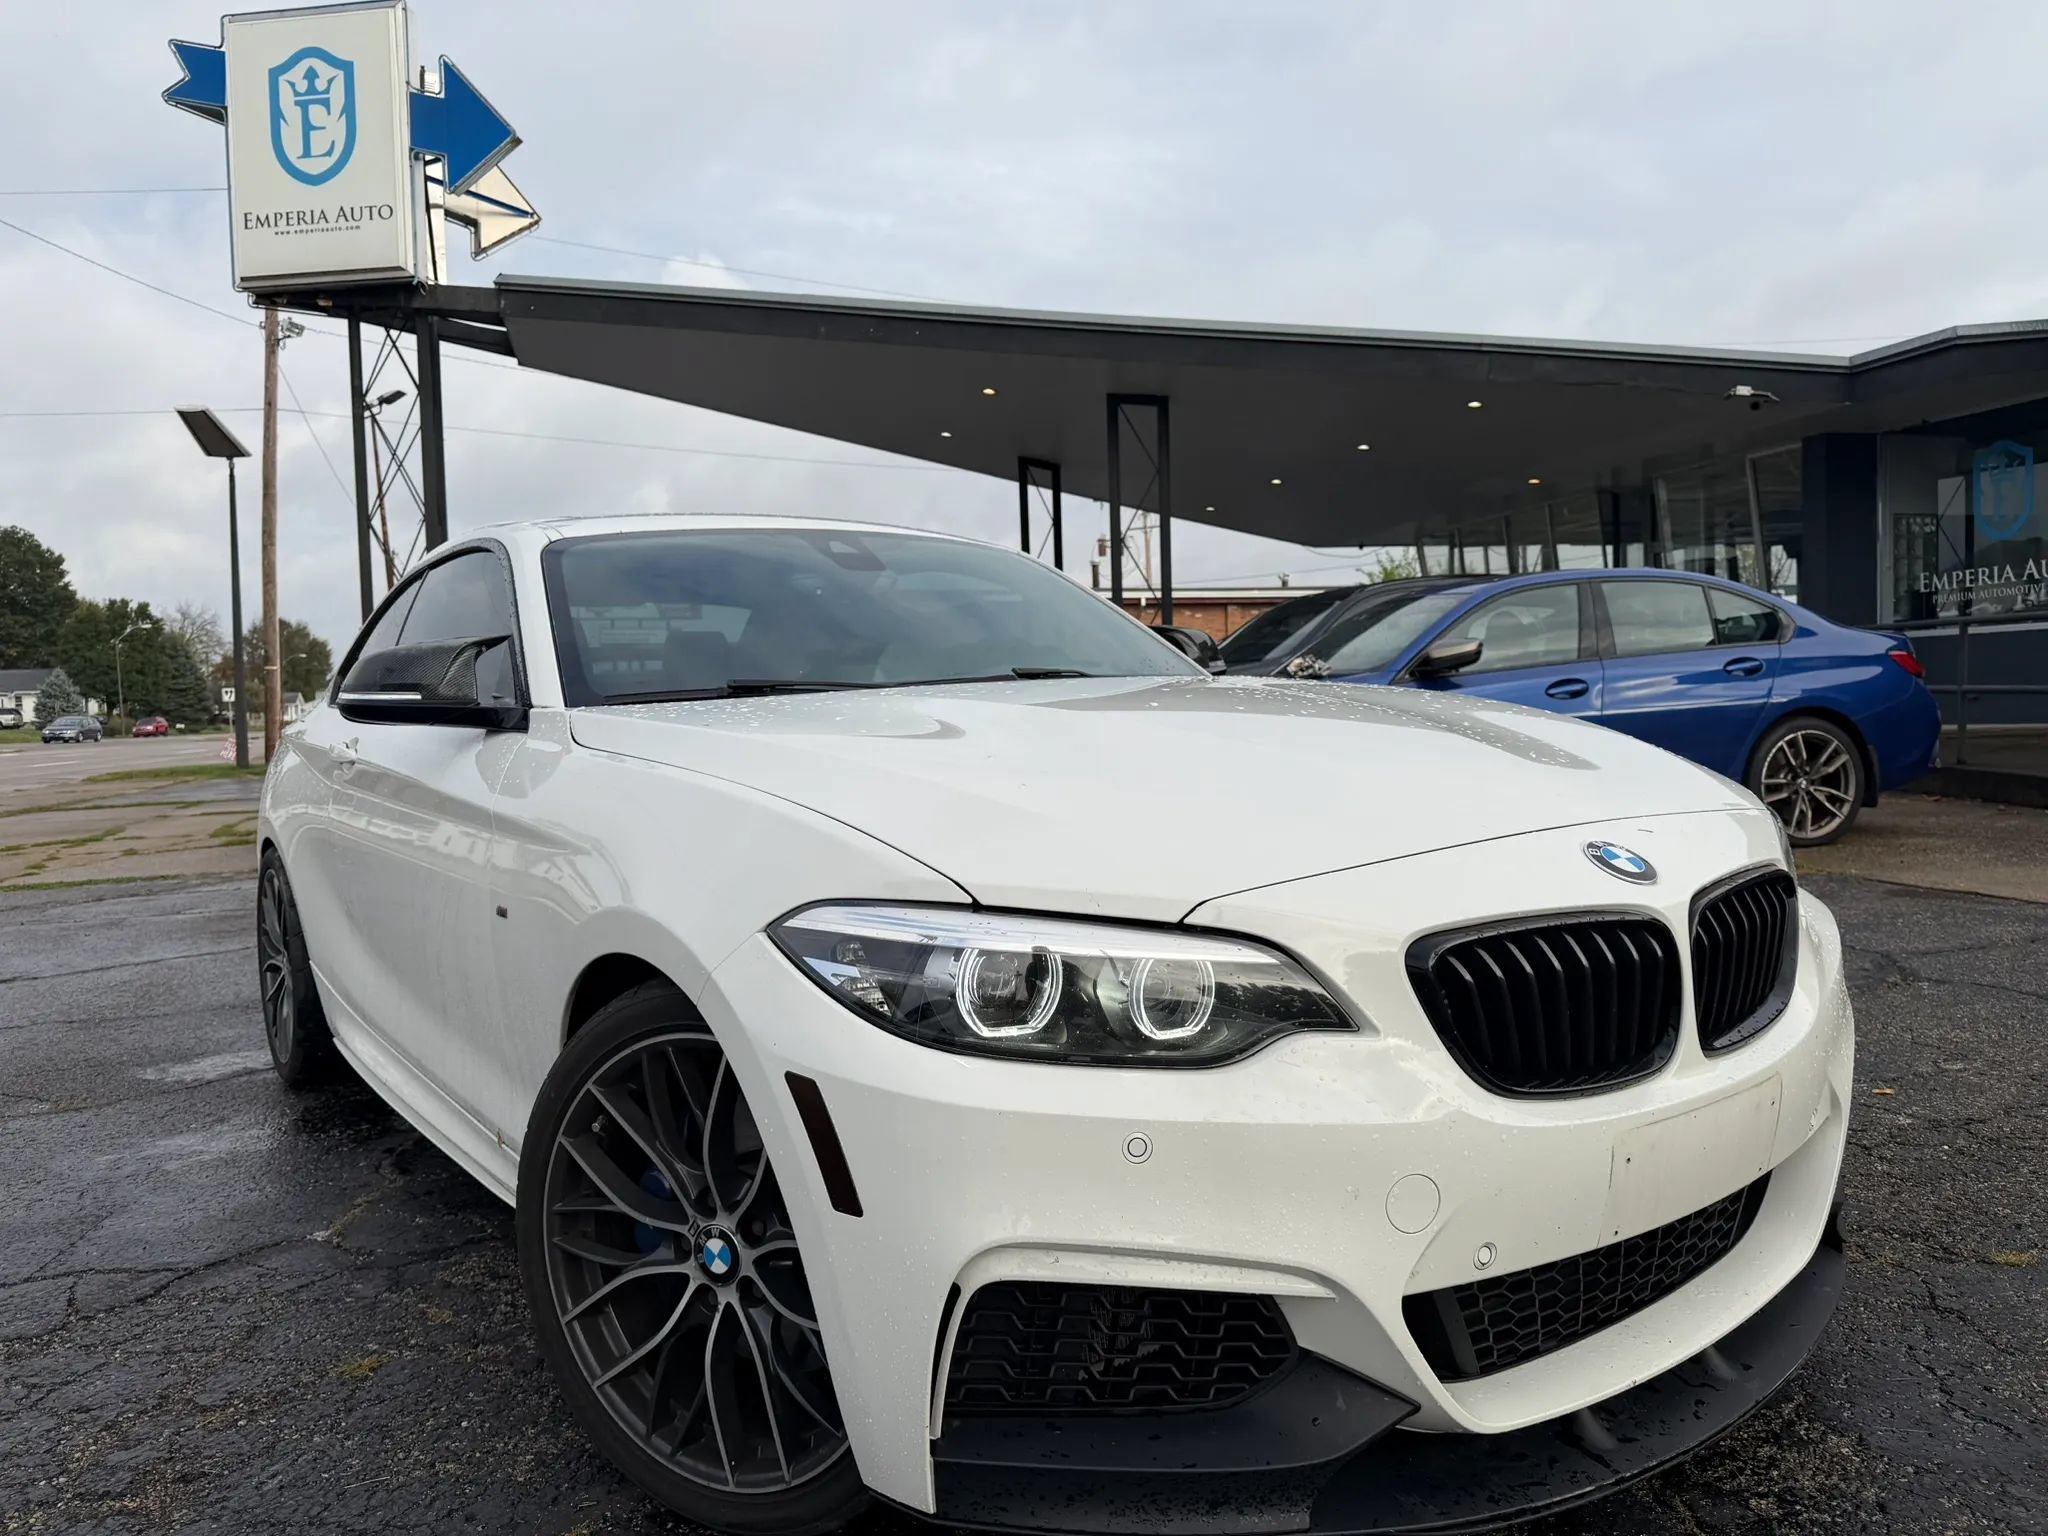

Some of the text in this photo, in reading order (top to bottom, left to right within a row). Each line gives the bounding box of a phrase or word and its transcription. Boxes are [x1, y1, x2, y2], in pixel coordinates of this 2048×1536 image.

[243, 204, 394, 230] EMPERIA AUTO
[274, 225, 361, 236] www.emperiaauto.com
[1919, 563, 2017, 593] EMPERIA
[1932, 582, 2046, 604] PREMIUM AUTOMOTIVE
